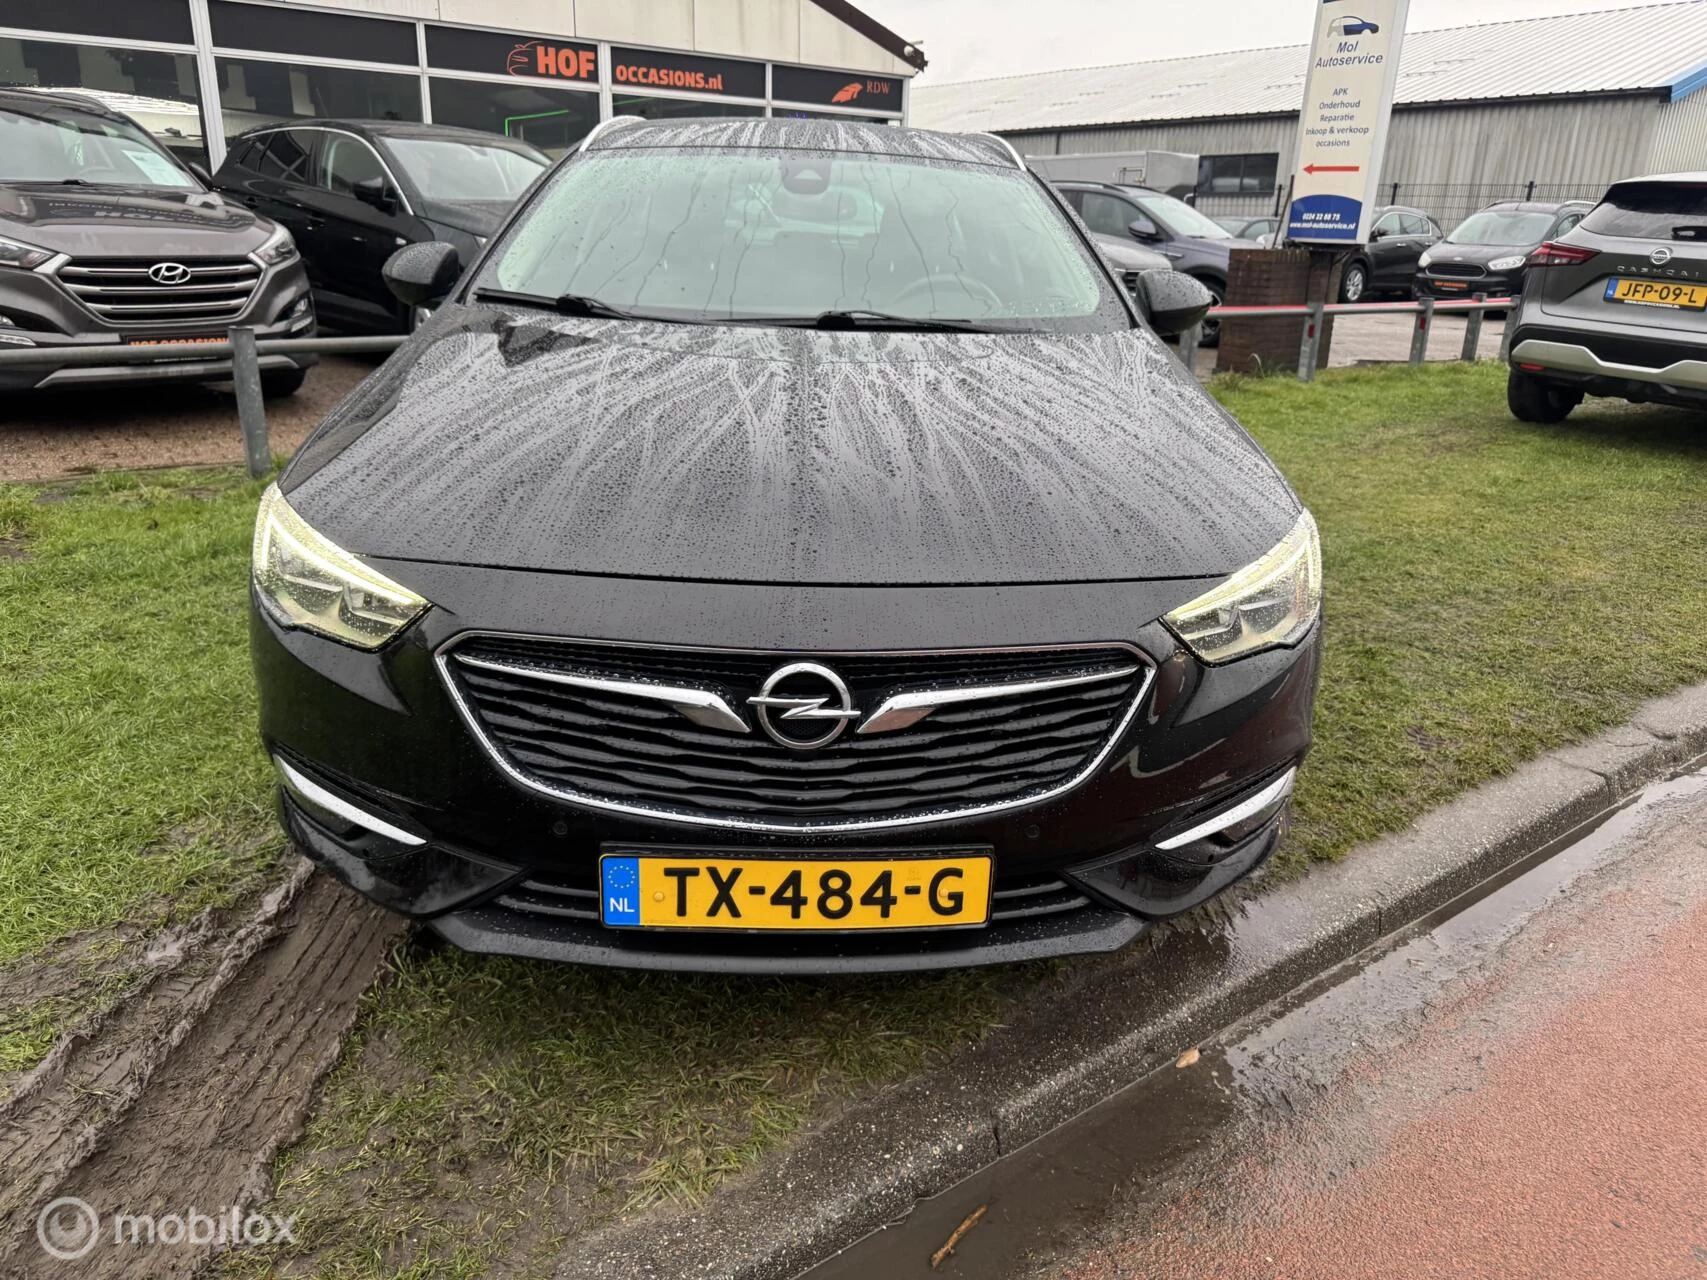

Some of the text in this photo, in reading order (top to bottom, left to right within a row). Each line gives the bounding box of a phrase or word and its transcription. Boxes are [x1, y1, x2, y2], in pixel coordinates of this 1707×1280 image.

[1336, 41, 1359, 54] Mol
[1315, 53, 1383, 68] Autoservice
[537, 45, 723, 90] HOF OCCASIONS.nl
[866, 81, 891, 94] RDW
[1333, 88, 1348, 96] APK
[1319, 100, 1361, 110] Onderhoud
[1320, 113, 1354, 123] Reparatie
[1306, 126, 1369, 136] Inkoop & verkoop
[1316, 139, 1350, 147] occasions
[1622, 283, 1697, 304] JFP-09-L
[609, 866, 964, 920] NL TX-484-G
